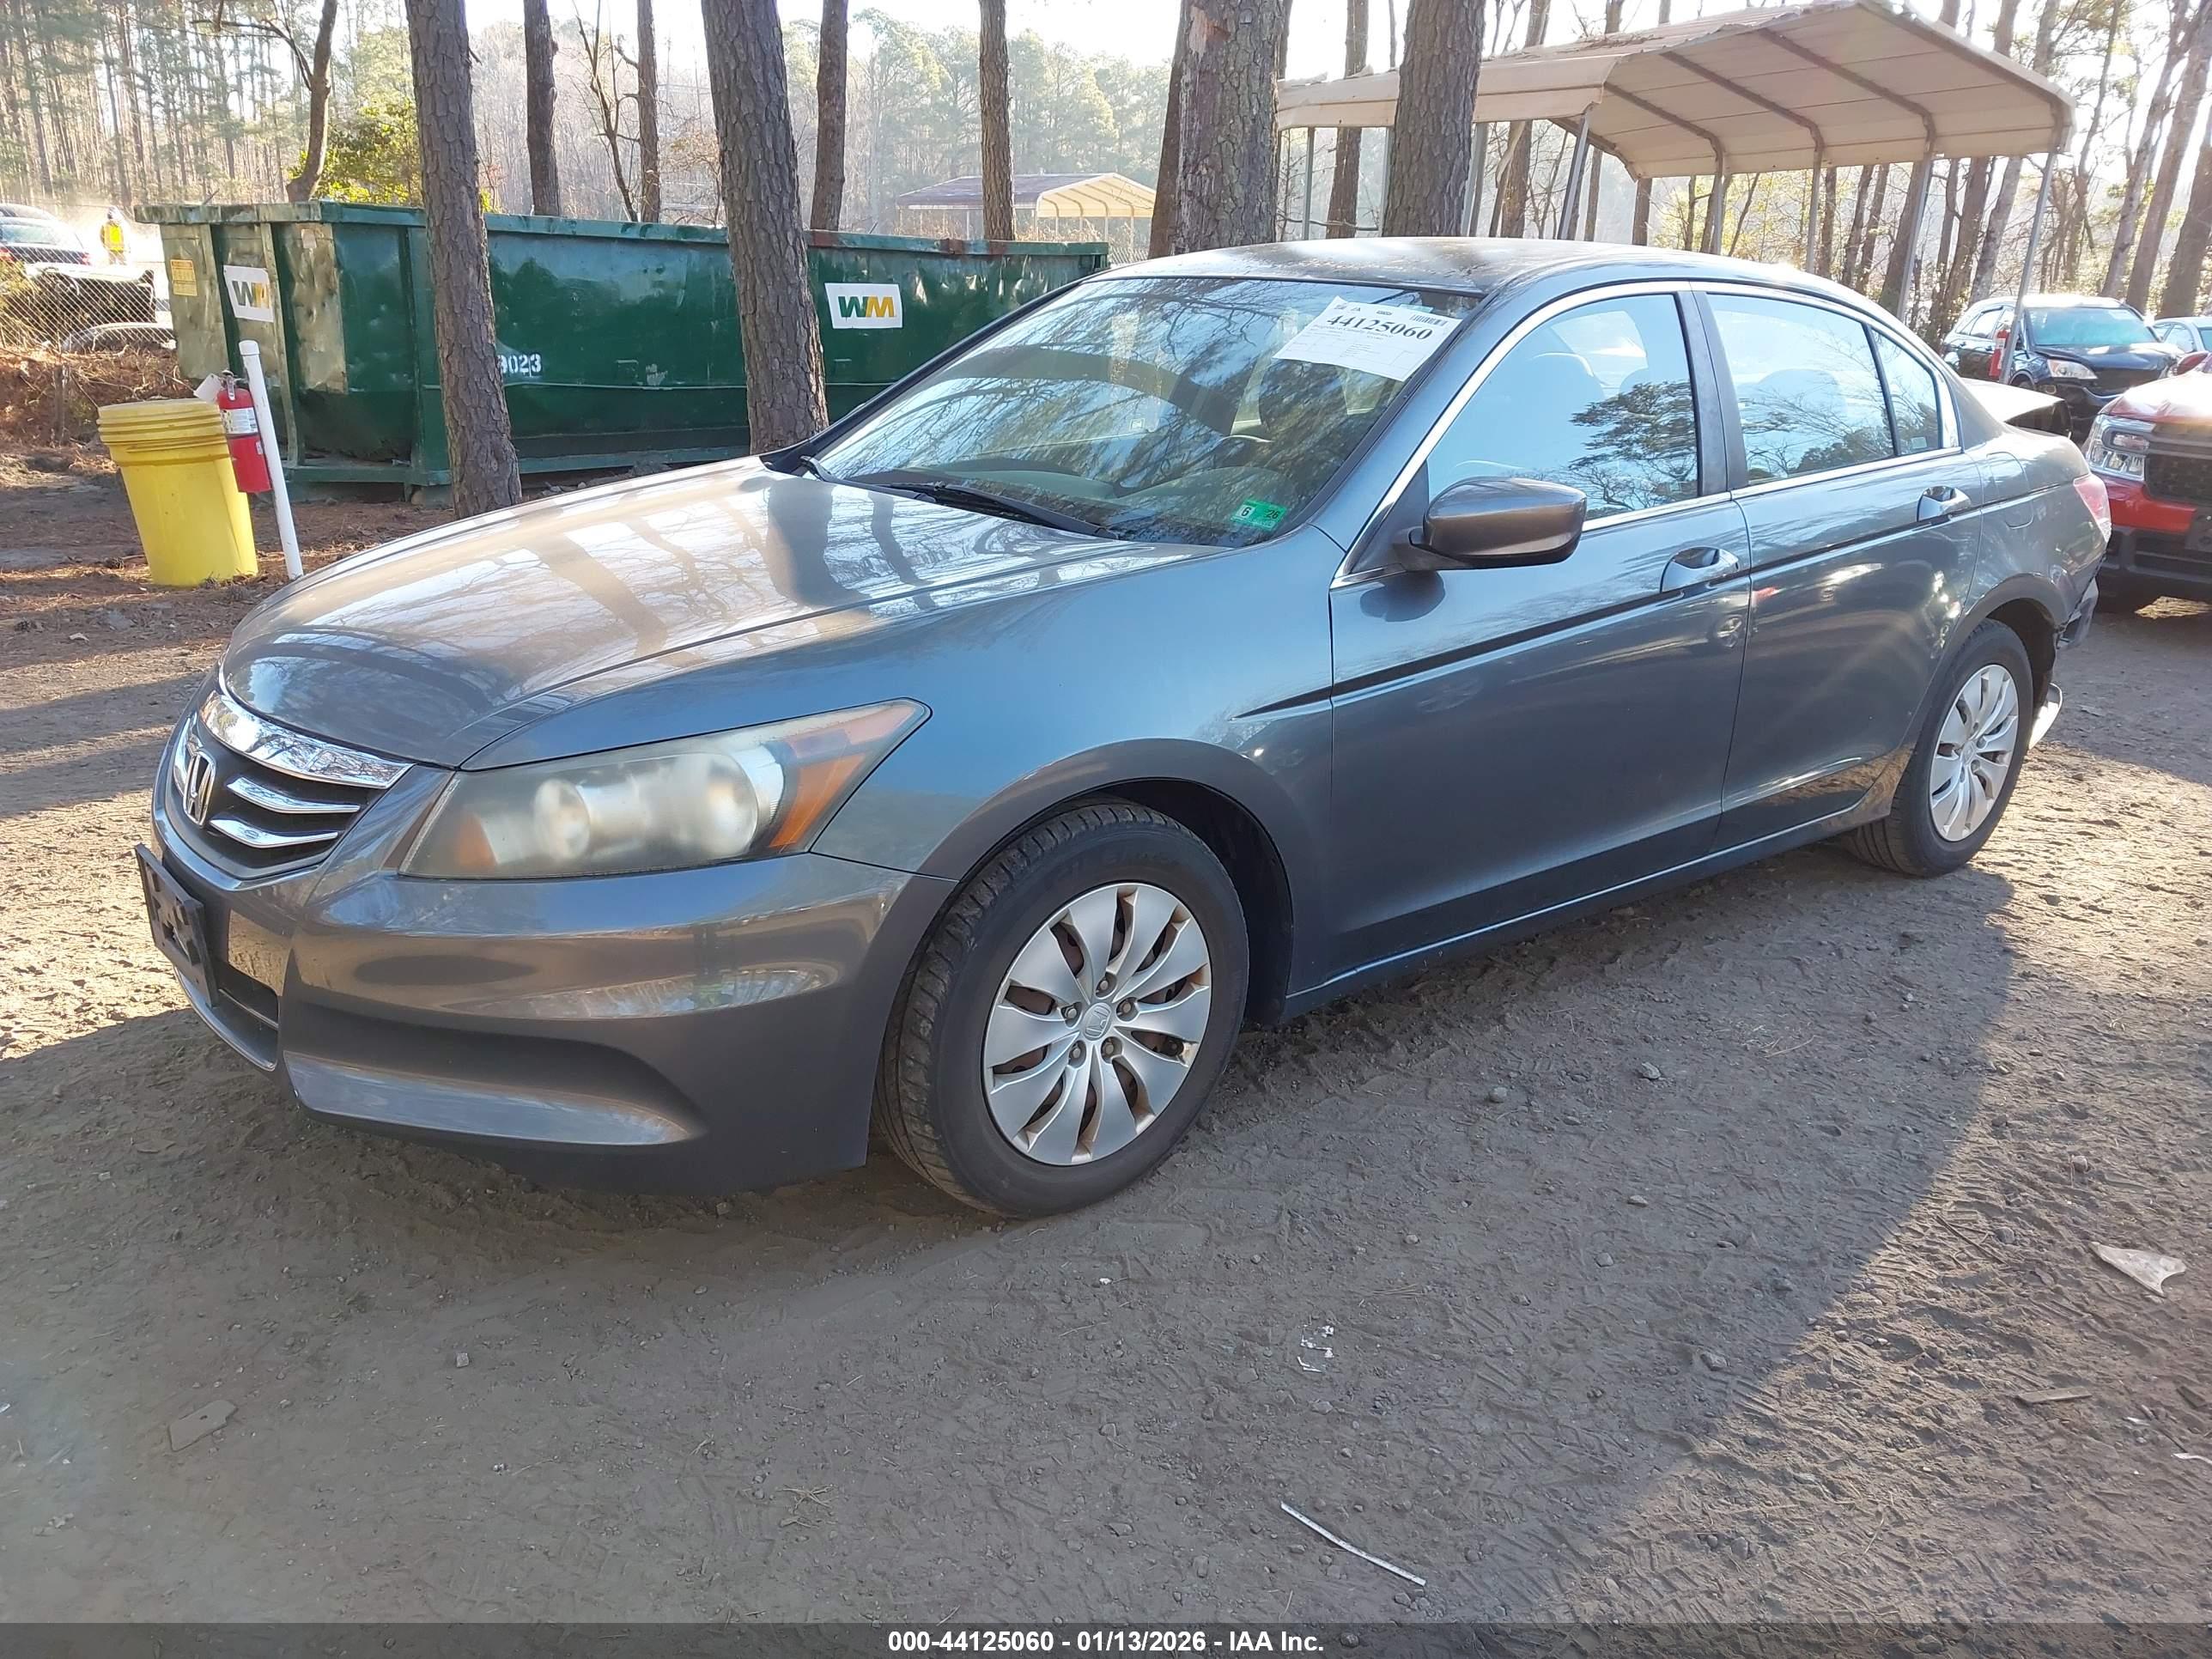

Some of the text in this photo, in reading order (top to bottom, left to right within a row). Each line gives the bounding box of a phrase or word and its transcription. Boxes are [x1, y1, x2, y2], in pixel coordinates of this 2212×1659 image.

[838, 296, 895, 318] WM
[1327, 315, 1433, 340] 44125060
[1241, 507, 1252, 517] 6
